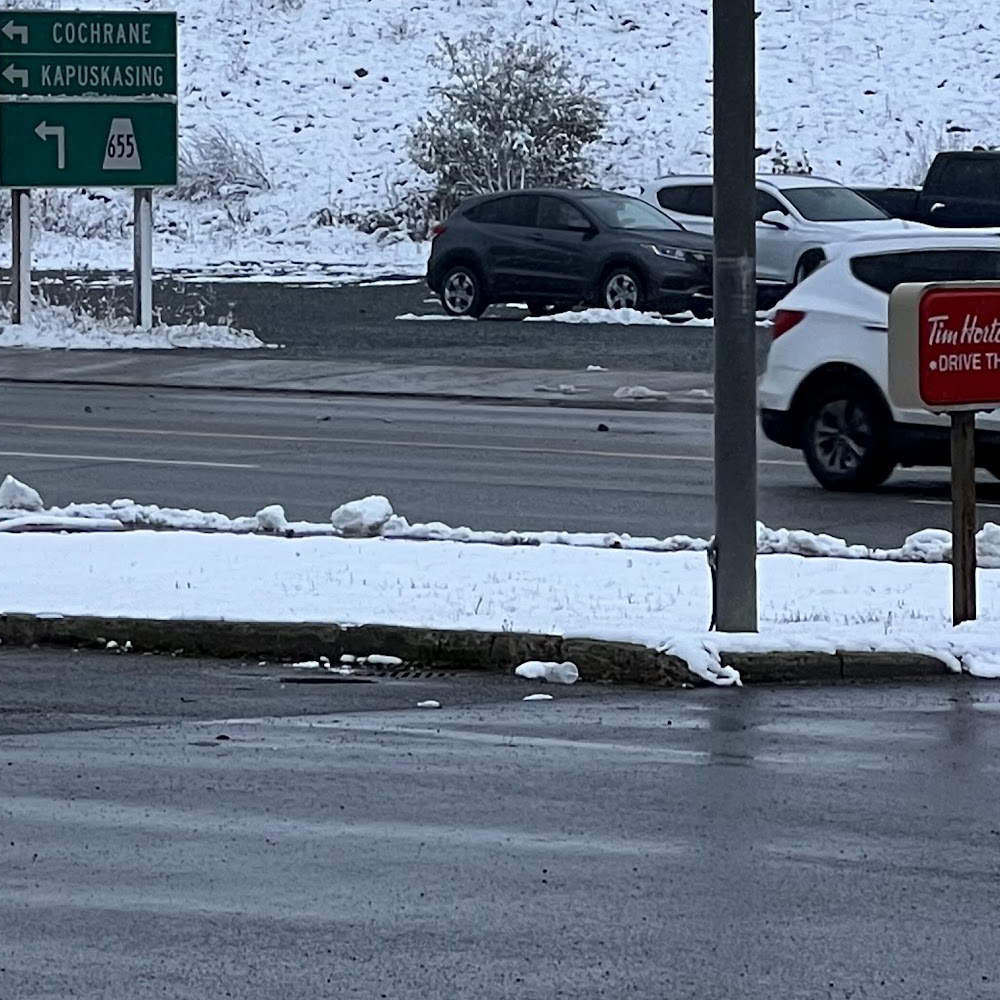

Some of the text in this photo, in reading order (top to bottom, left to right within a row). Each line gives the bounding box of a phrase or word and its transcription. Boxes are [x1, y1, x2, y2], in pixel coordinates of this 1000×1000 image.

[52, 22, 152, 44] COCHRANE
[41, 65, 163, 87] KAPUSKASING
[107, 134, 134, 158] 655
[928, 314, 958, 346] Tim
[939, 353, 981, 372] DRIVE
